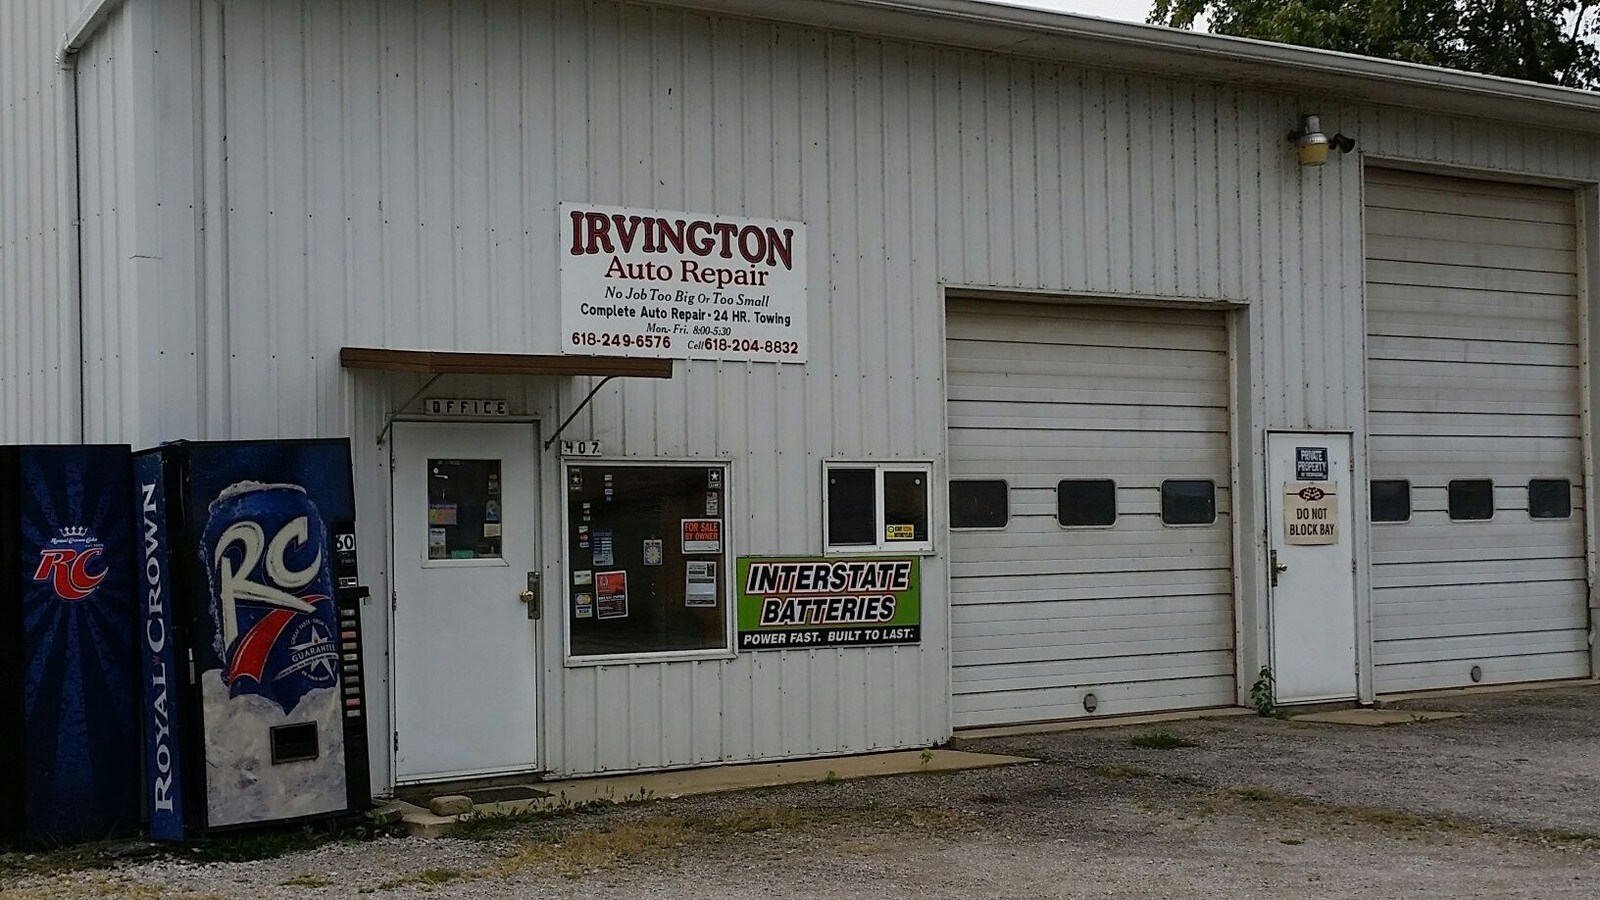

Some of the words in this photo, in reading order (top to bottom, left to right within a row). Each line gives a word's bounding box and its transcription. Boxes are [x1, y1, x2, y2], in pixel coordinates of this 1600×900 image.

[570, 210, 794, 270] IRVINGTON
[604, 255, 673, 282] Auto
[680, 259, 769, 289] Repair
[605, 286, 623, 299] No
[625, 287, 647, 301] Job
[650, 289, 672, 302] Too
[674, 290, 695, 306] Big
[697, 293, 711, 304] Or
[713, 292, 734, 305] Too
[736, 294, 770, 307] Small
[580, 302, 636, 323] Complete
[640, 306, 667, 319] Auto
[713, 309, 729, 322] 24
[732, 311, 750, 323] HR.
[754, 312, 791, 326] Towing
[673, 324, 689, 335] Fri.
[692, 326, 732, 336] 8:00-5:30
[571, 332, 672, 349] 618-249-6576
[704, 338, 799, 354] 618-204-8832
[432, 400, 506, 415] OFFICE
[564, 441, 600, 454] 407
[1300, 450, 1323, 461] PRIVATE
[1297, 461, 1327, 472] PROPERTY
[1296, 508, 1310, 520] DO
[1312, 508, 1328, 520] NOT
[684, 522, 699, 532] FOR
[700, 521, 718, 531] SALE
[684, 532, 694, 541] BY
[695, 531, 719, 541] OWNER
[1289, 524, 1318, 536] BLOCK
[1320, 523, 1335, 536] BAY
[33, 546, 109, 600] RC
[142, 483, 166, 653] CROWN
[747, 560, 912, 594] INTERSTATE
[215, 515, 323, 655] RC
[760, 595, 896, 626] BATTERIES
[744, 633, 786, 645] POWER
[789, 632, 821, 643] FAST.
[827, 630, 862, 642] BUILT
[864, 630, 880, 641] TO
[882, 629, 914, 640] LAST.
[154, 662, 174, 813] ROYAL
